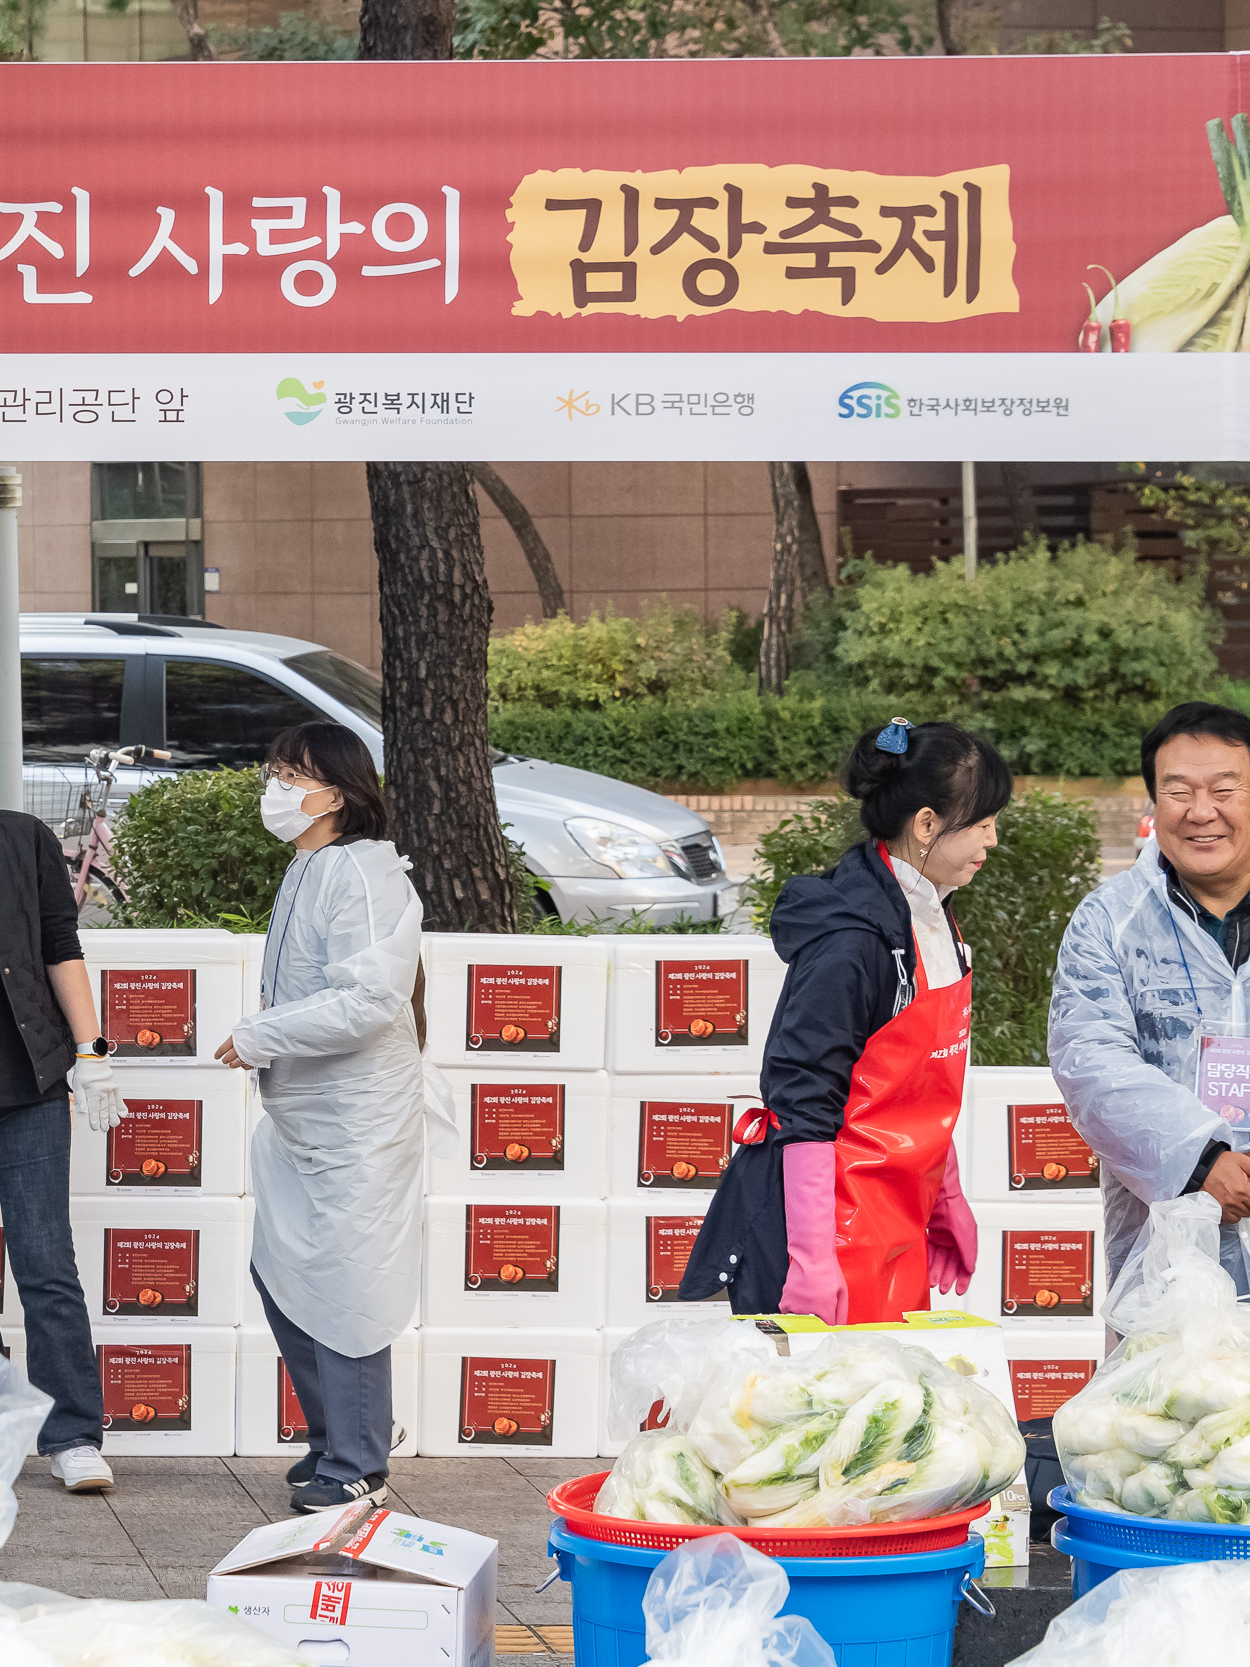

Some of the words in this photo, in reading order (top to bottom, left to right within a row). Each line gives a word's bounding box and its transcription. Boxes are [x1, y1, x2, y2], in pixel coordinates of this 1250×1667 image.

[129, 185, 460, 307] 사랑의
[545, 182, 982, 306] 김장축제
[155, 387, 189, 423] 앞
[334, 391, 476, 415] 광진복지재단
[611, 393, 655, 416] KB
[661, 391, 755, 417] 국민은행
[838, 384, 901, 419] SSiS
[906, 397, 1069, 417] 한국사회보장정보원
[335, 417, 378, 427] Gwangjin
[382, 416, 417, 425] Welfare
[420, 416, 473, 425] Foundation
[129, 982, 140, 990] 광진
[142, 982, 159, 990] 사랑의
[496, 977, 507, 985] 광진
[508, 977, 525, 985] 사랑의
[499, 1096, 510, 1104] 광진
[511, 1096, 528, 1104] 사랑의
[667, 1114, 679, 1122] 광진
[698, 1115, 721, 1123] 김장축제
[494, 1217, 505, 1225] 광진
[506, 1217, 523, 1225] 사랑의
[132, 1241, 144, 1249] 광진
[145, 1241, 162, 1249] 사랑의
[489, 1370, 500, 1378] 광진
[501, 1370, 518, 1378] 사랑의
[520, 1371, 542, 1379] 김장축제
[243, 1605, 271, 1616] 생산자
